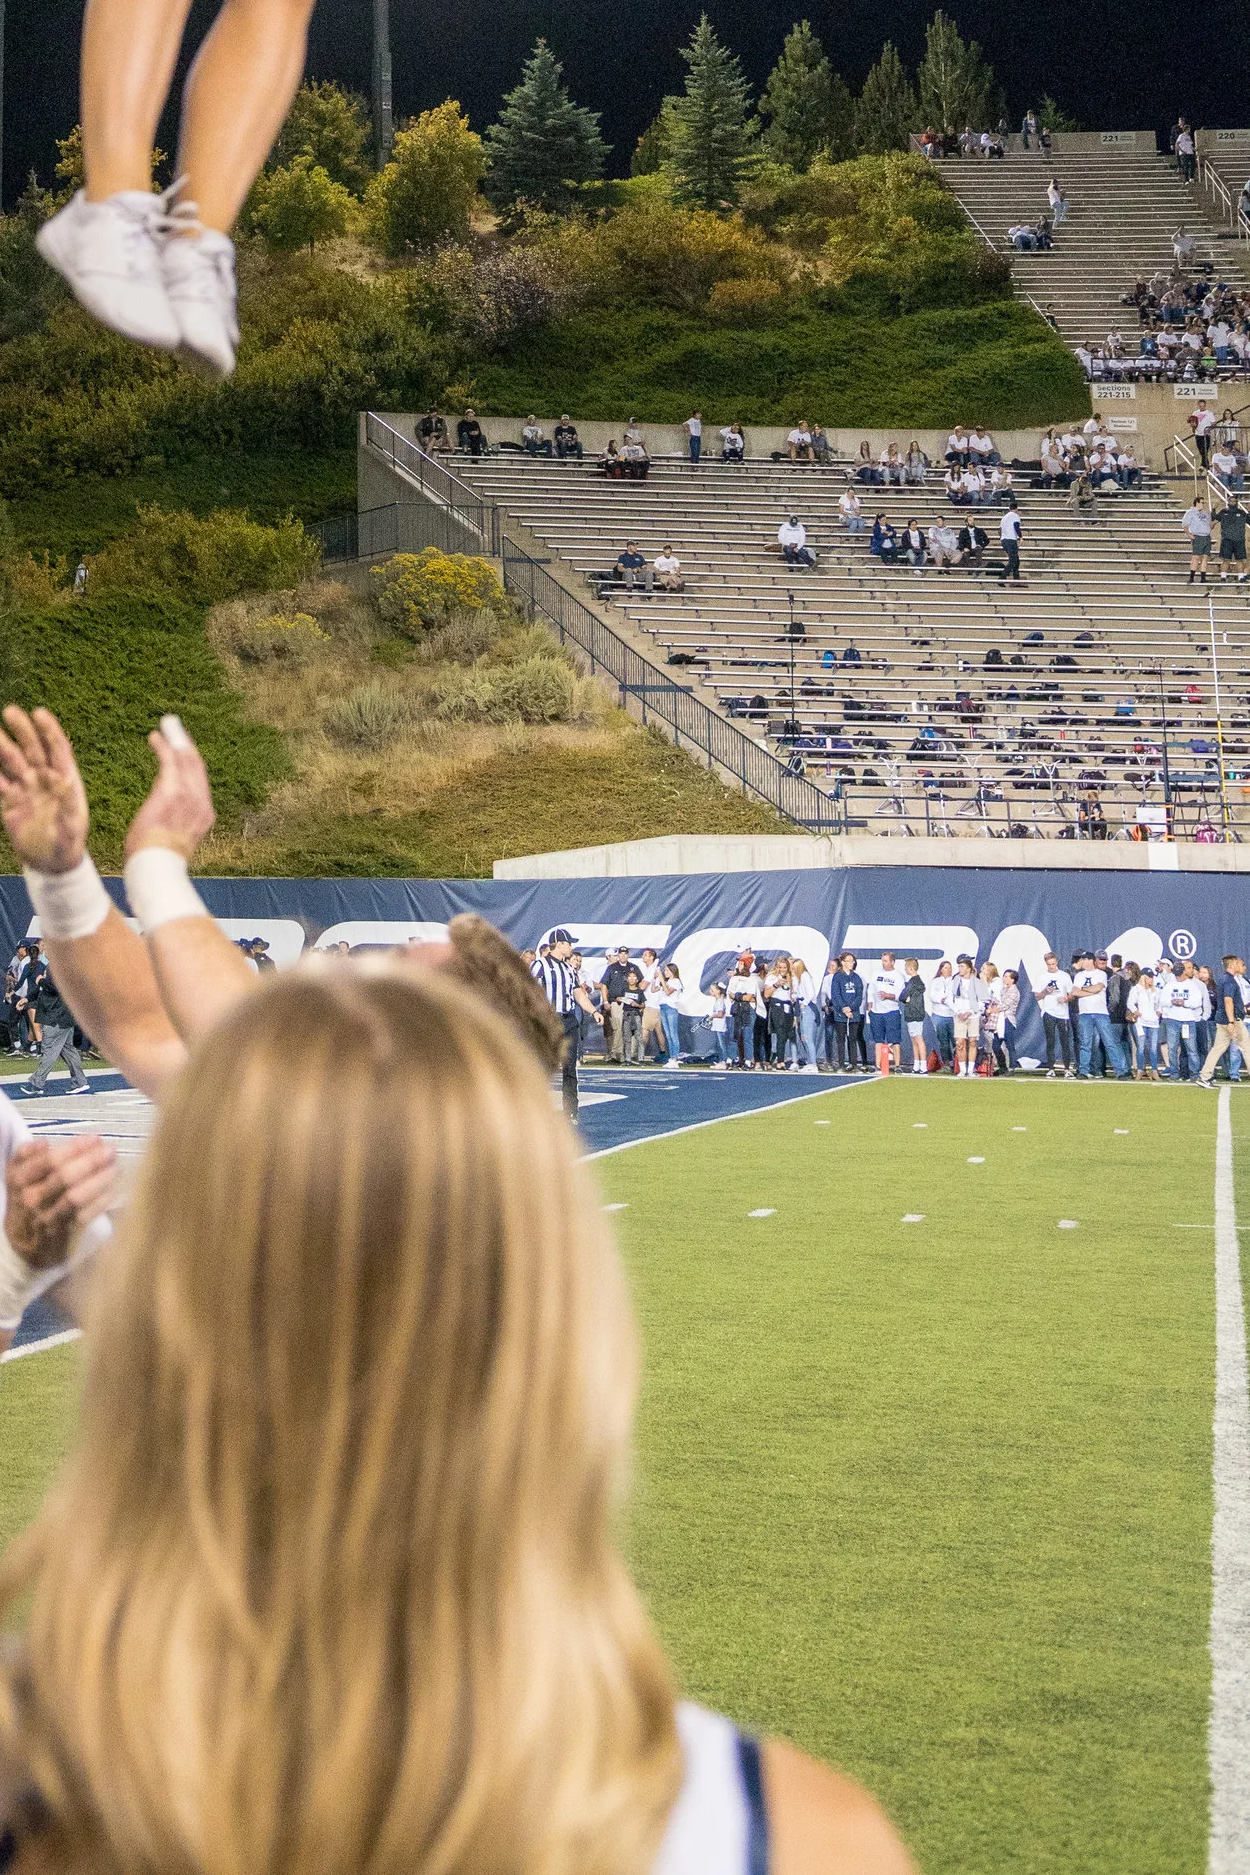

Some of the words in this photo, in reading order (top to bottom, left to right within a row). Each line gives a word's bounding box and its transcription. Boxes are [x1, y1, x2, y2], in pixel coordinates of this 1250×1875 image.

[1218, 132, 1236, 140] 220
[1097, 391, 1131, 399] 221-215
[1176, 387, 1196, 396] 221
